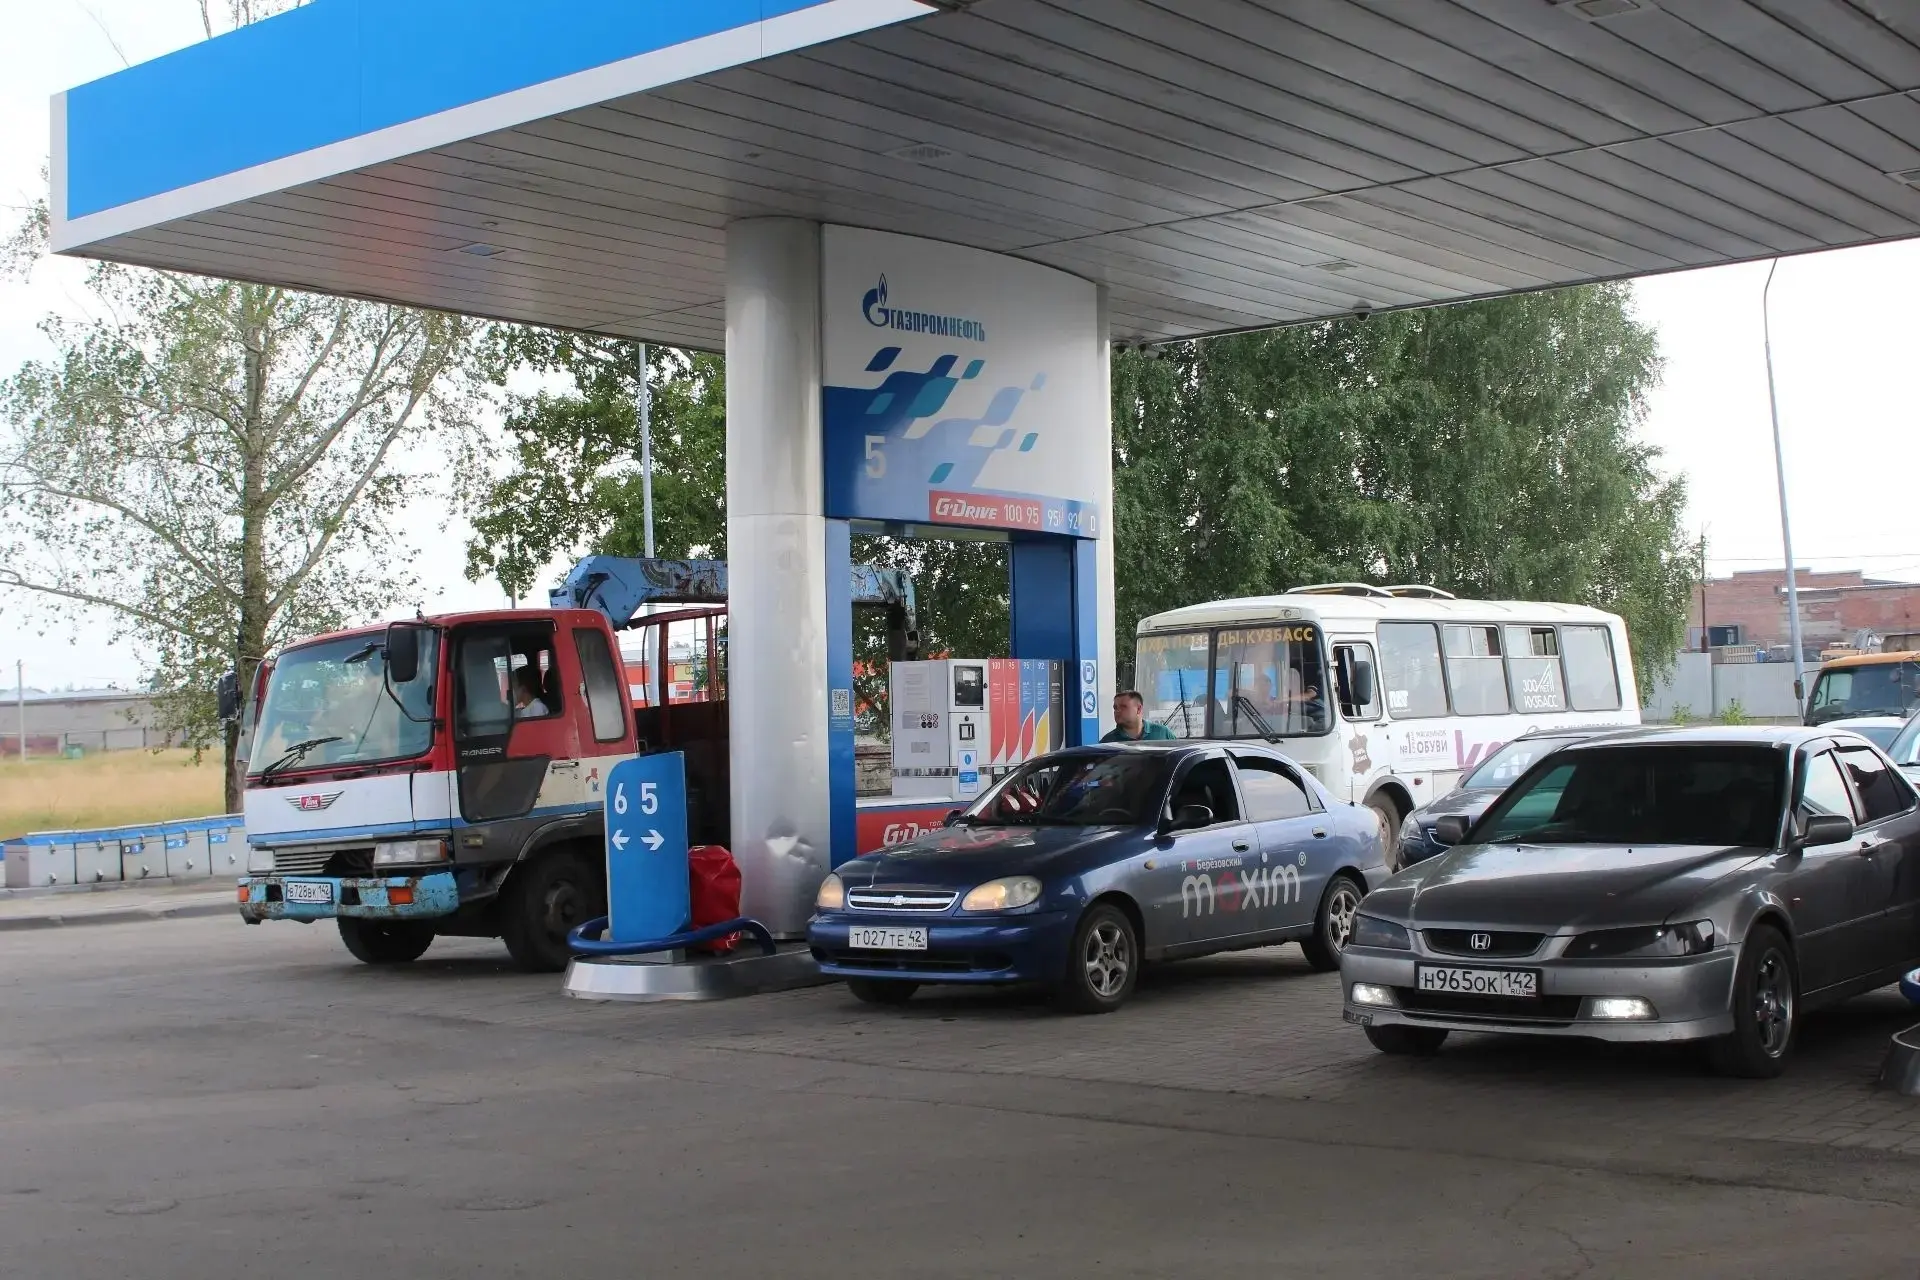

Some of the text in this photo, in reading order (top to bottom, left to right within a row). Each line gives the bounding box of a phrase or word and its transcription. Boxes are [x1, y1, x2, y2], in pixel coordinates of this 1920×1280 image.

[890, 308, 985, 341] ГАЗПРОМНЕФТЬ
[865, 435, 886, 479] 5
[1004, 504, 1022, 522] 100
[1027, 506, 1039, 525] 95
[461, 747, 502, 756] RANGER
[1416, 740, 1448, 754] ОБУВИ
[614, 782, 659, 815] 6 5
[1196, 855, 1243, 872] Берёзовский
[908, 930, 922, 943] 42
[1503, 972, 1533, 989] 142
[1510, 988, 1526, 996] RUS
